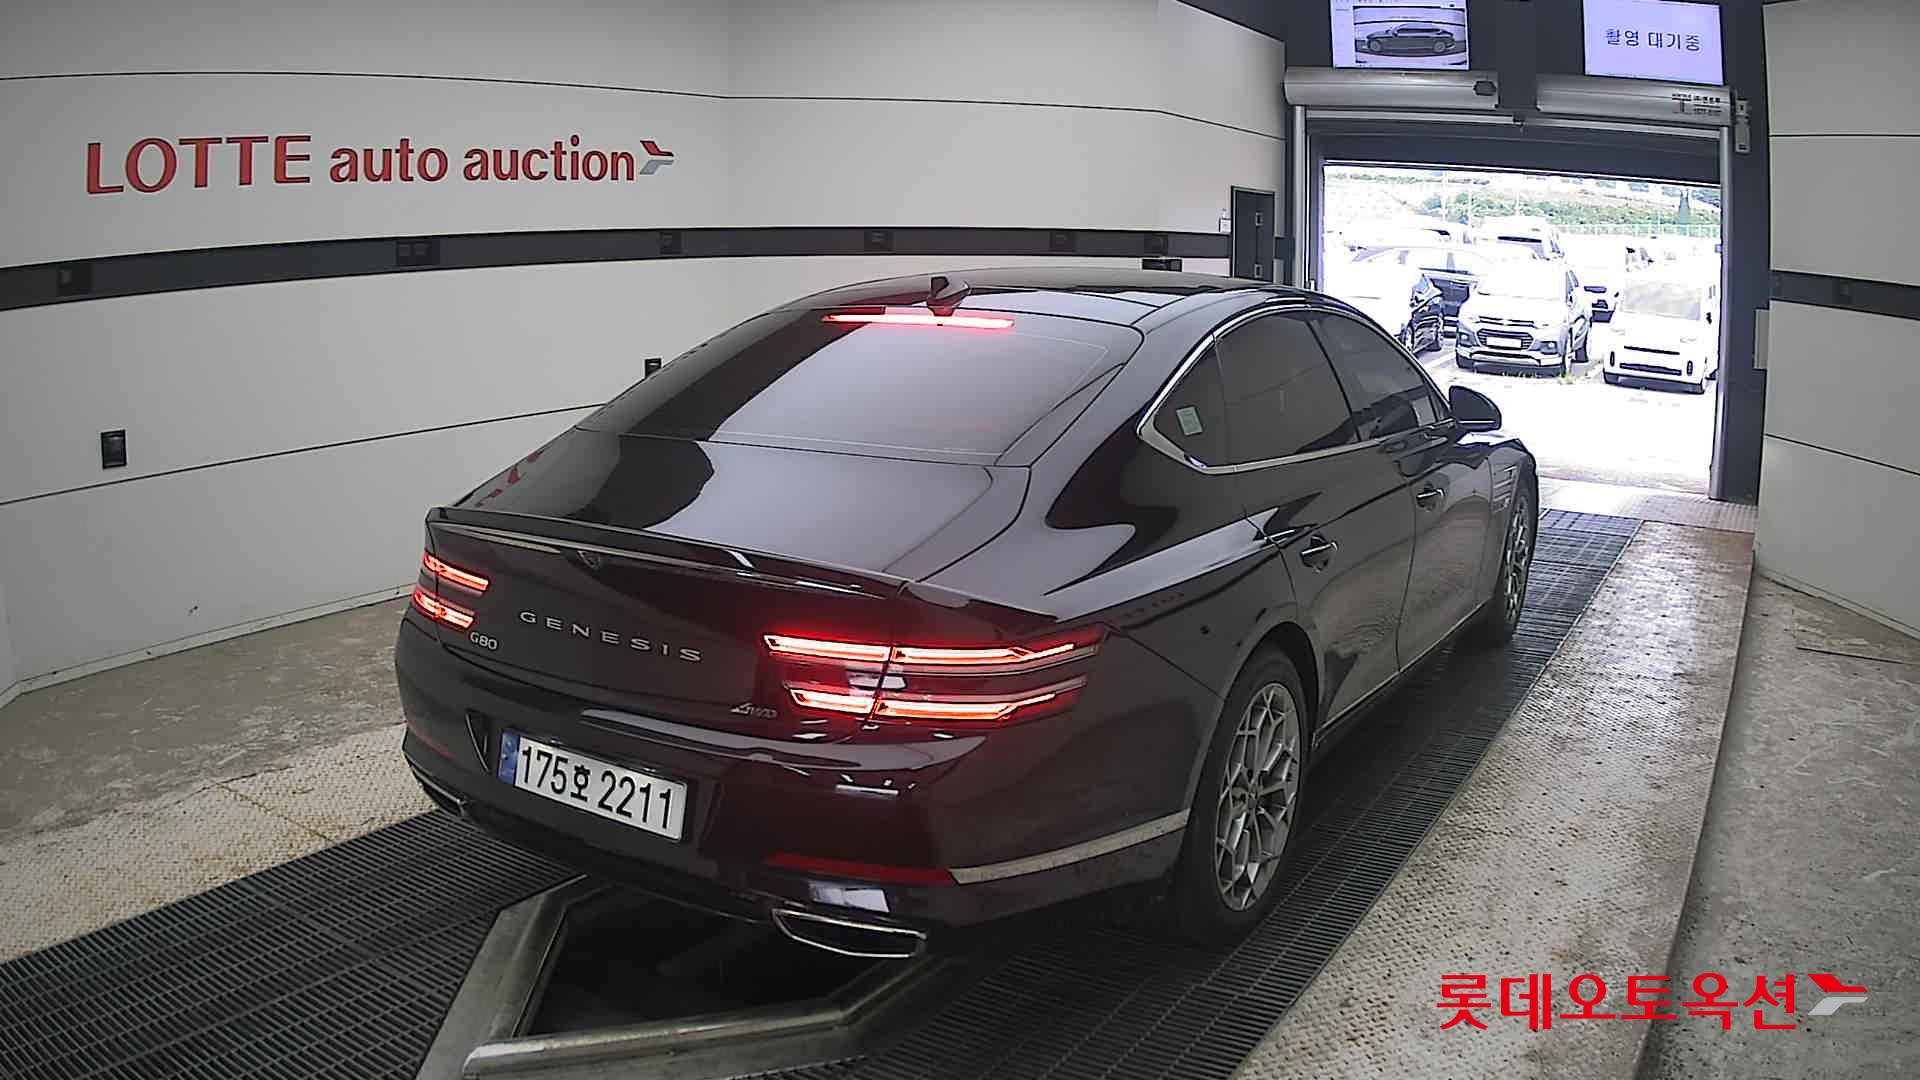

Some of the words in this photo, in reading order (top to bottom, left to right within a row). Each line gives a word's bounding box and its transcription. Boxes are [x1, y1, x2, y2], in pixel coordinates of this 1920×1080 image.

[1647, 31, 1700, 52] 대기중
[87, 135, 311, 194] LOTTE
[329, 138, 449, 183] auto
[463, 135, 636, 182] auction
[469, 631, 498, 650] G80
[519, 611, 701, 662] GENESIS
[522, 746, 591, 802] 175호
[598, 769, 672, 830] 2211
